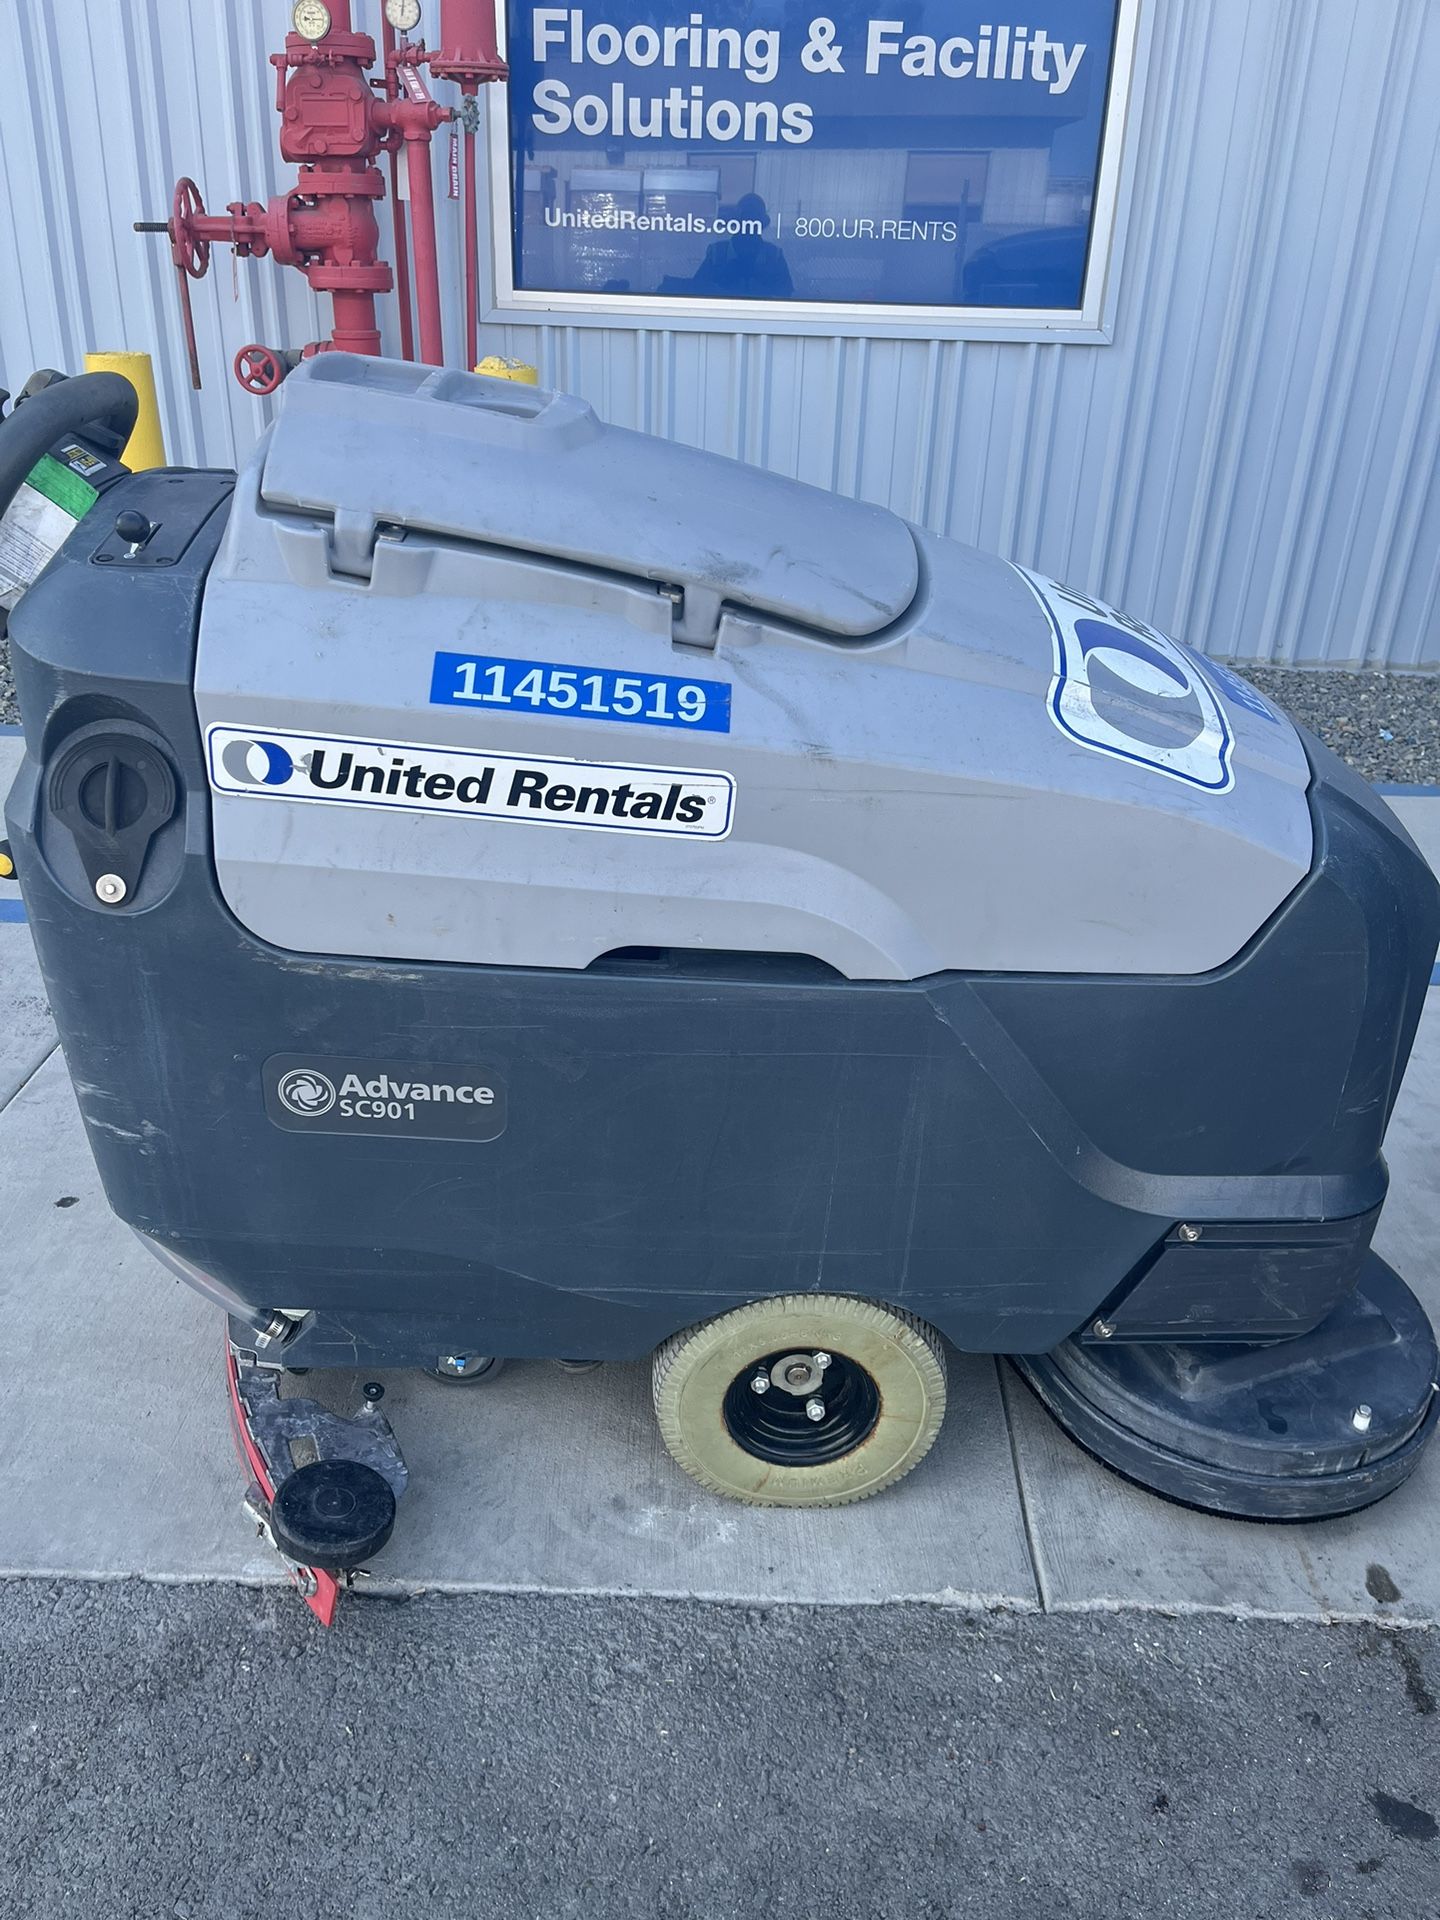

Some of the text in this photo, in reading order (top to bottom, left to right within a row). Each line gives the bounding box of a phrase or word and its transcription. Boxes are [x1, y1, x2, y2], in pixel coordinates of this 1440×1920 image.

[532, 7, 1087, 96] Flooring & Facility
[531, 78, 815, 144] Solutions
[544, 207, 958, 243] UnitedRentals.com 800.UR.RENTS
[452, 661, 707, 723] 11451519
[308, 749, 706, 823] United Rentals
[338, 1073, 495, 1105] Advance
[339, 1099, 415, 1120] SC901
